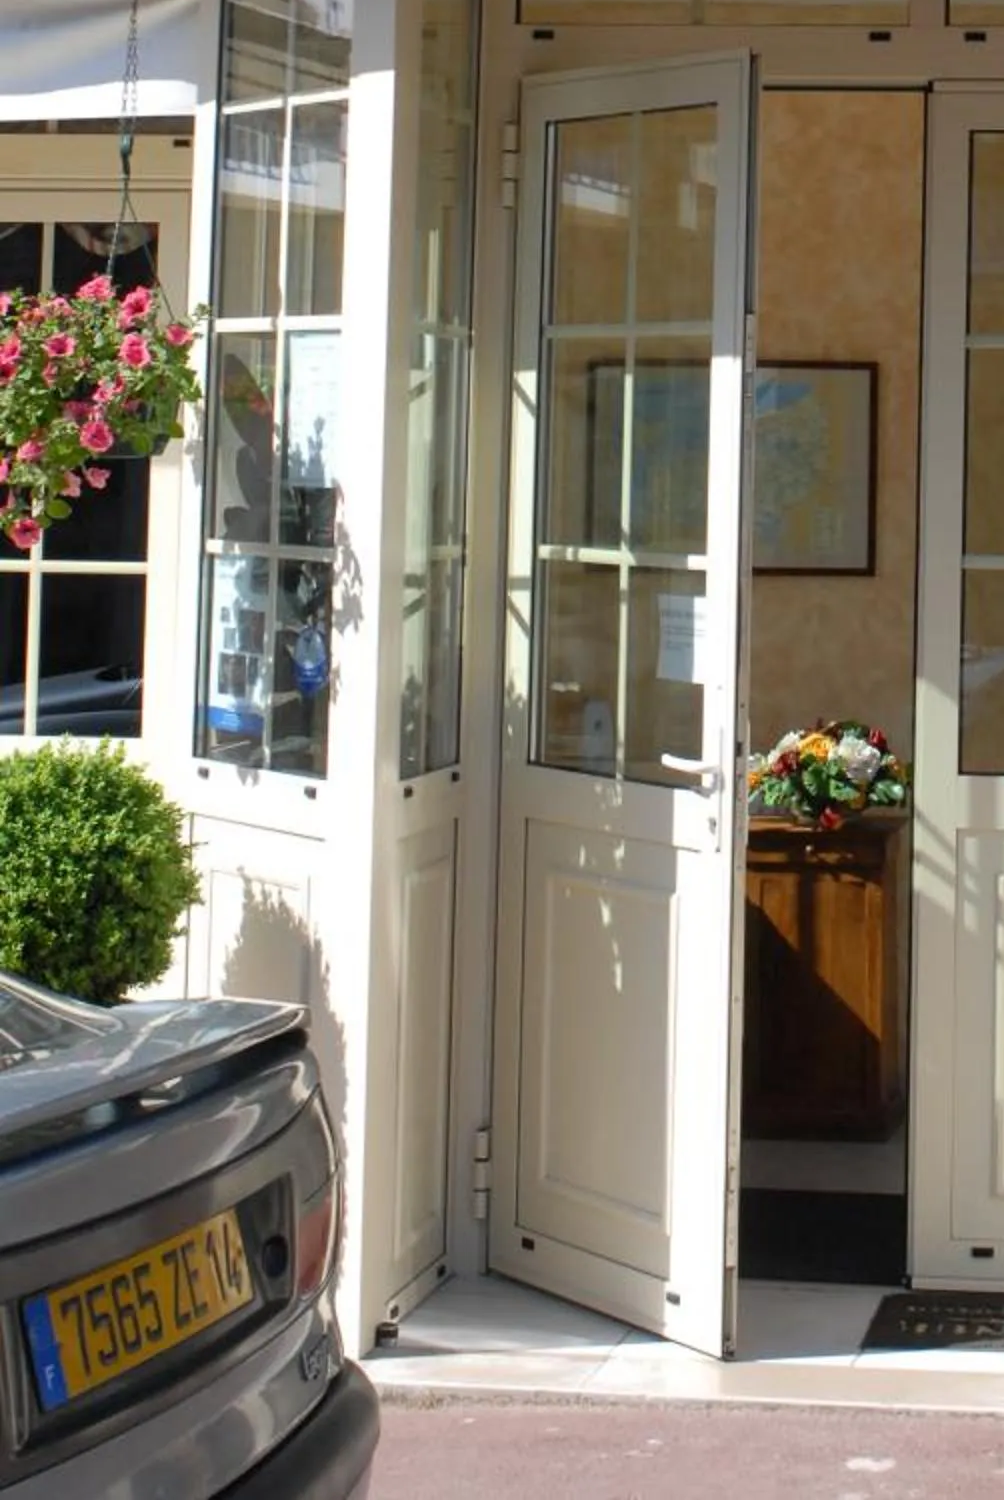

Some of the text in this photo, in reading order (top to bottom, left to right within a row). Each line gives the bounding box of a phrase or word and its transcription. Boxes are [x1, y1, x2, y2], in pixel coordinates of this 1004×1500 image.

[60, 1221, 243, 1377] 7565 ZE 14
